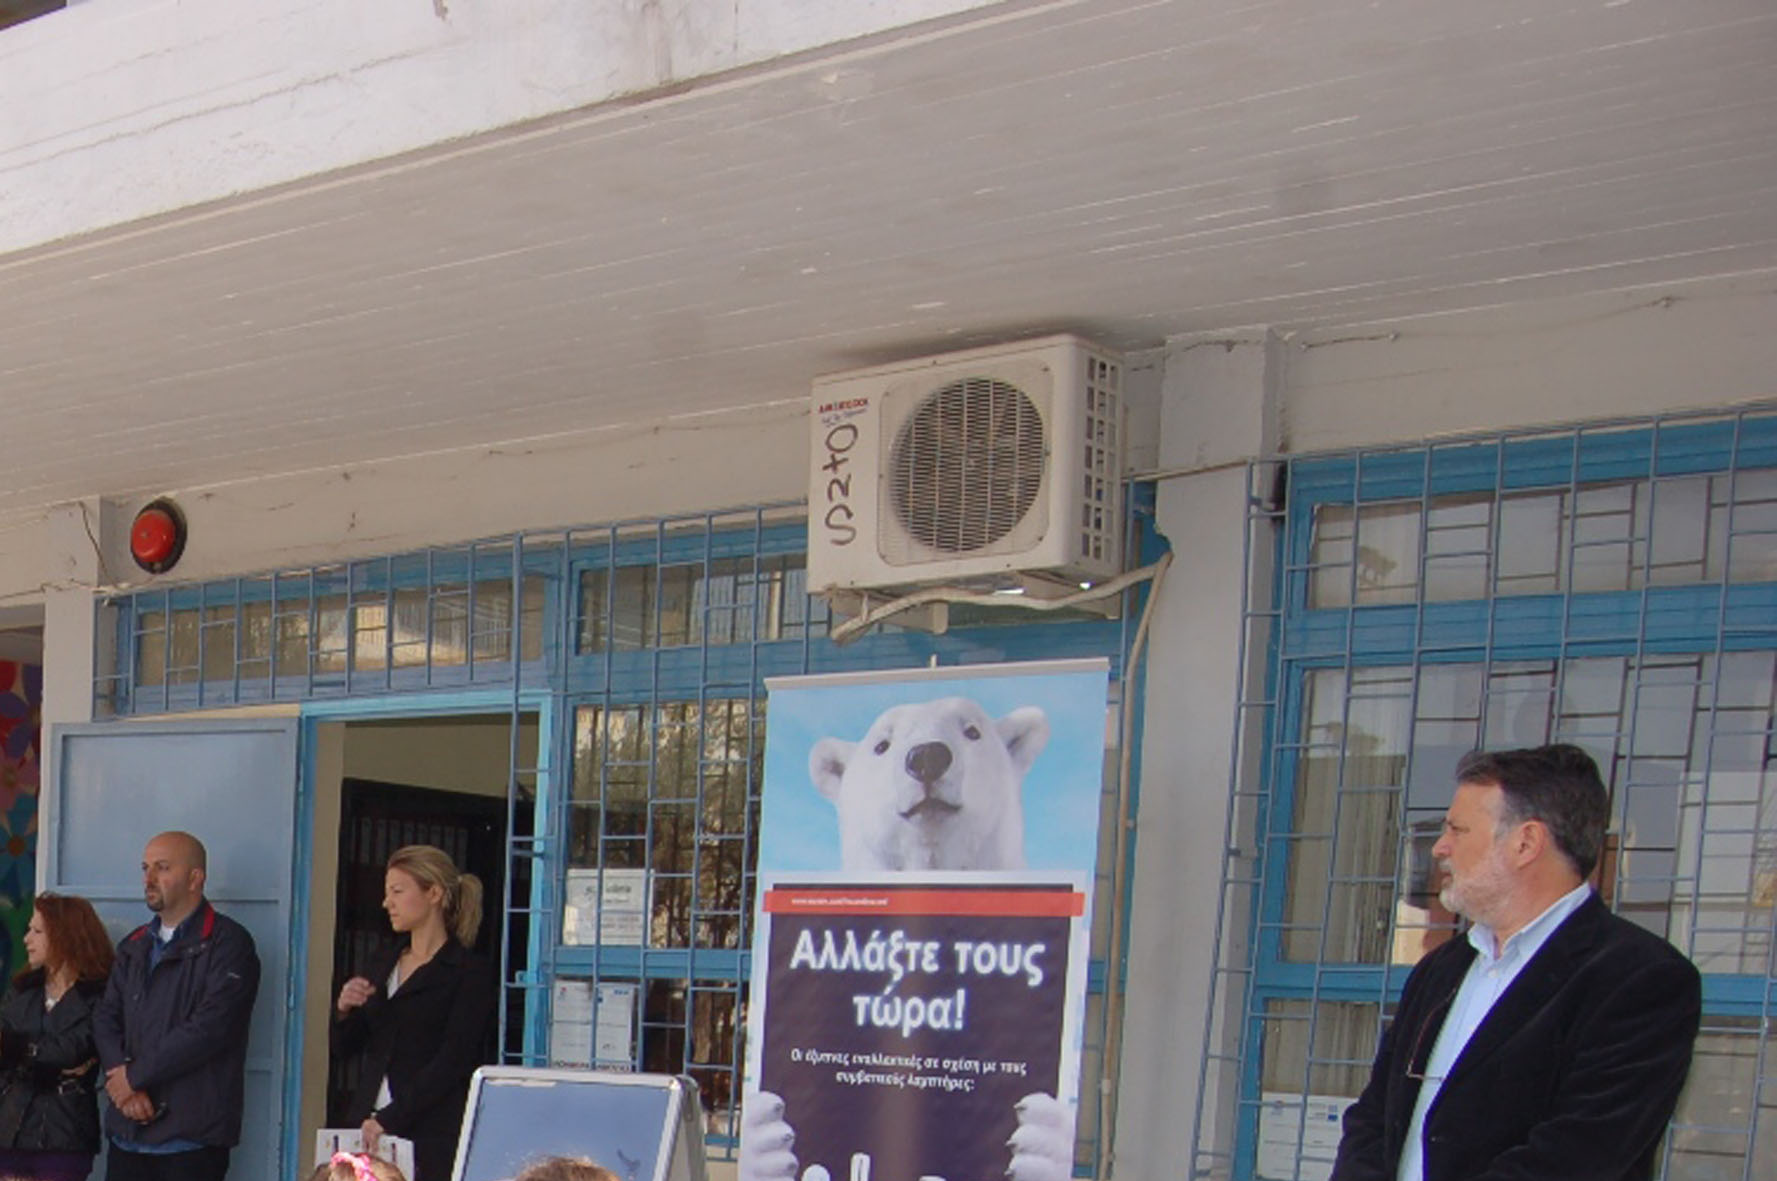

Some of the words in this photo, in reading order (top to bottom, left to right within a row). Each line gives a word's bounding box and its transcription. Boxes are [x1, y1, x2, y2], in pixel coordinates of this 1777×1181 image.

[789, 928, 942, 982] Αλλάξτε
[953, 940, 1047, 988] τους
[851, 985, 967, 1038] τώρα!
[790, 1048, 803, 1062] Οι
[923, 1056, 940, 1070] σε
[941, 1056, 981, 1075] σχέση
[982, 1060, 998, 1075] με
